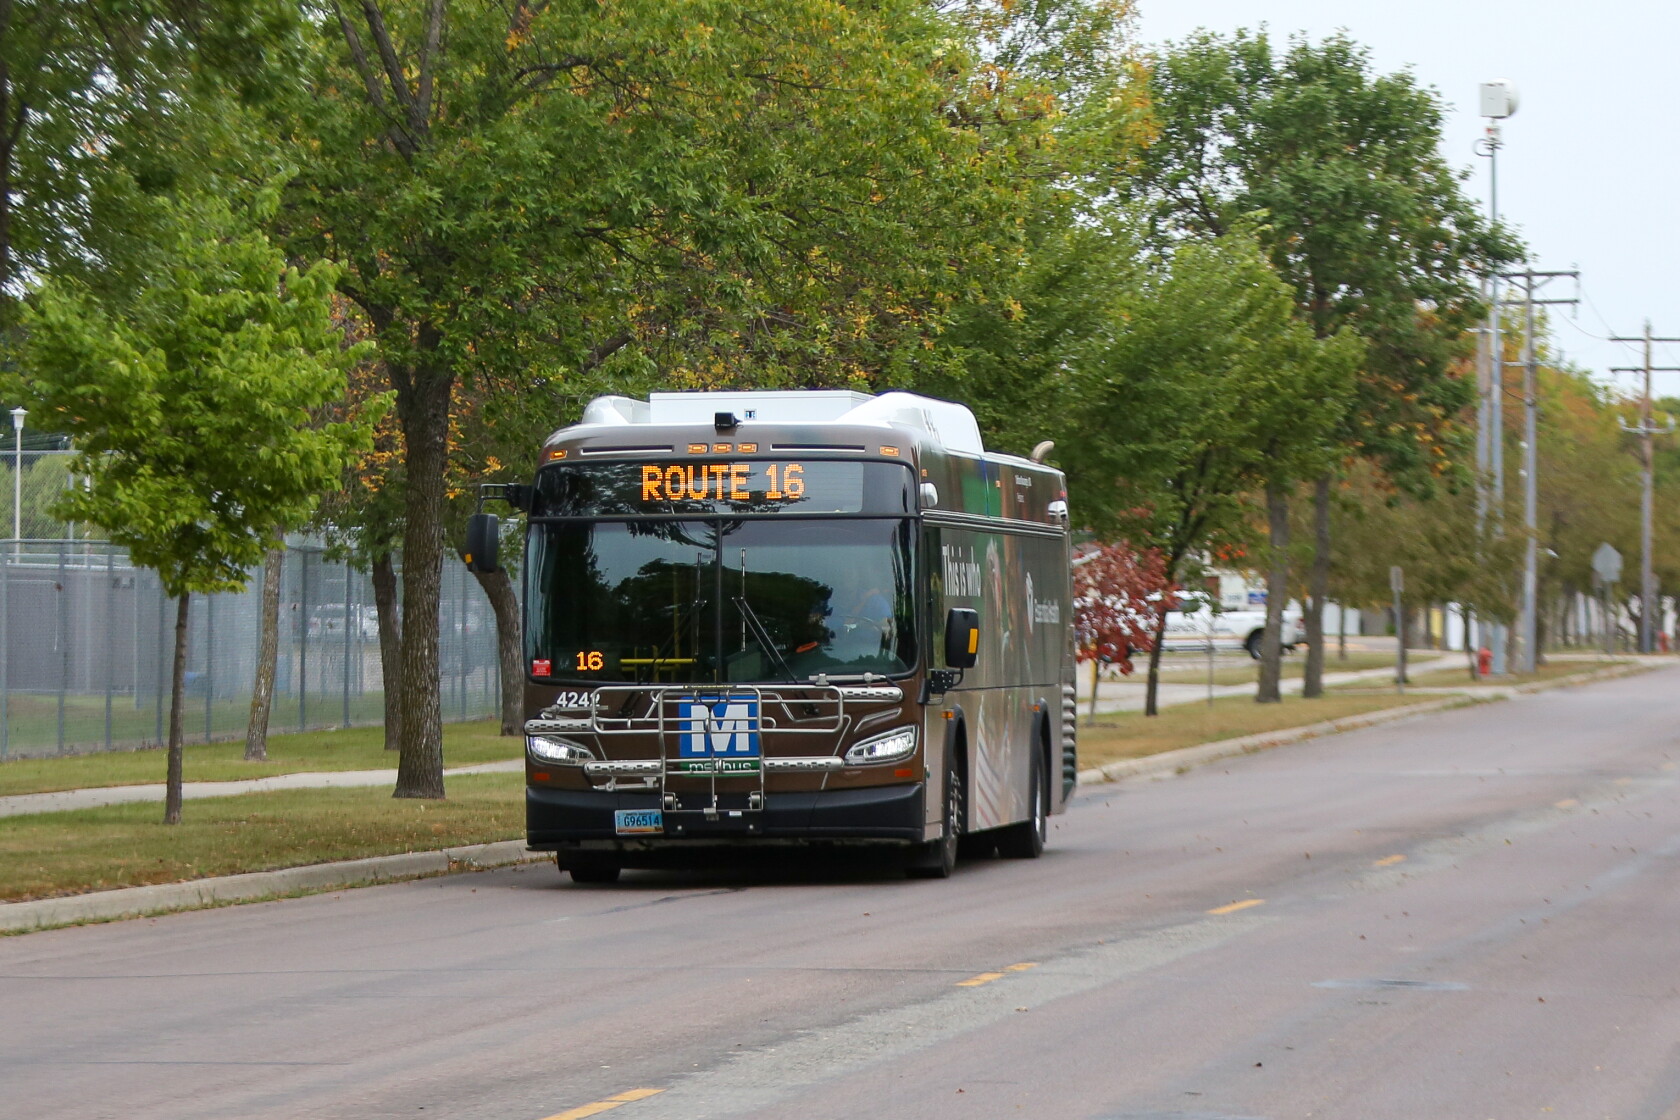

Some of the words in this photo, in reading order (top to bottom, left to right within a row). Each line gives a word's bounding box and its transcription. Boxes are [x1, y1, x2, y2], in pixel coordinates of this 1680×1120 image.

[642, 464, 750, 501] ROUTE
[765, 463, 805, 500] 16
[576, 651, 604, 671] 16
[690, 703, 750, 752] M
